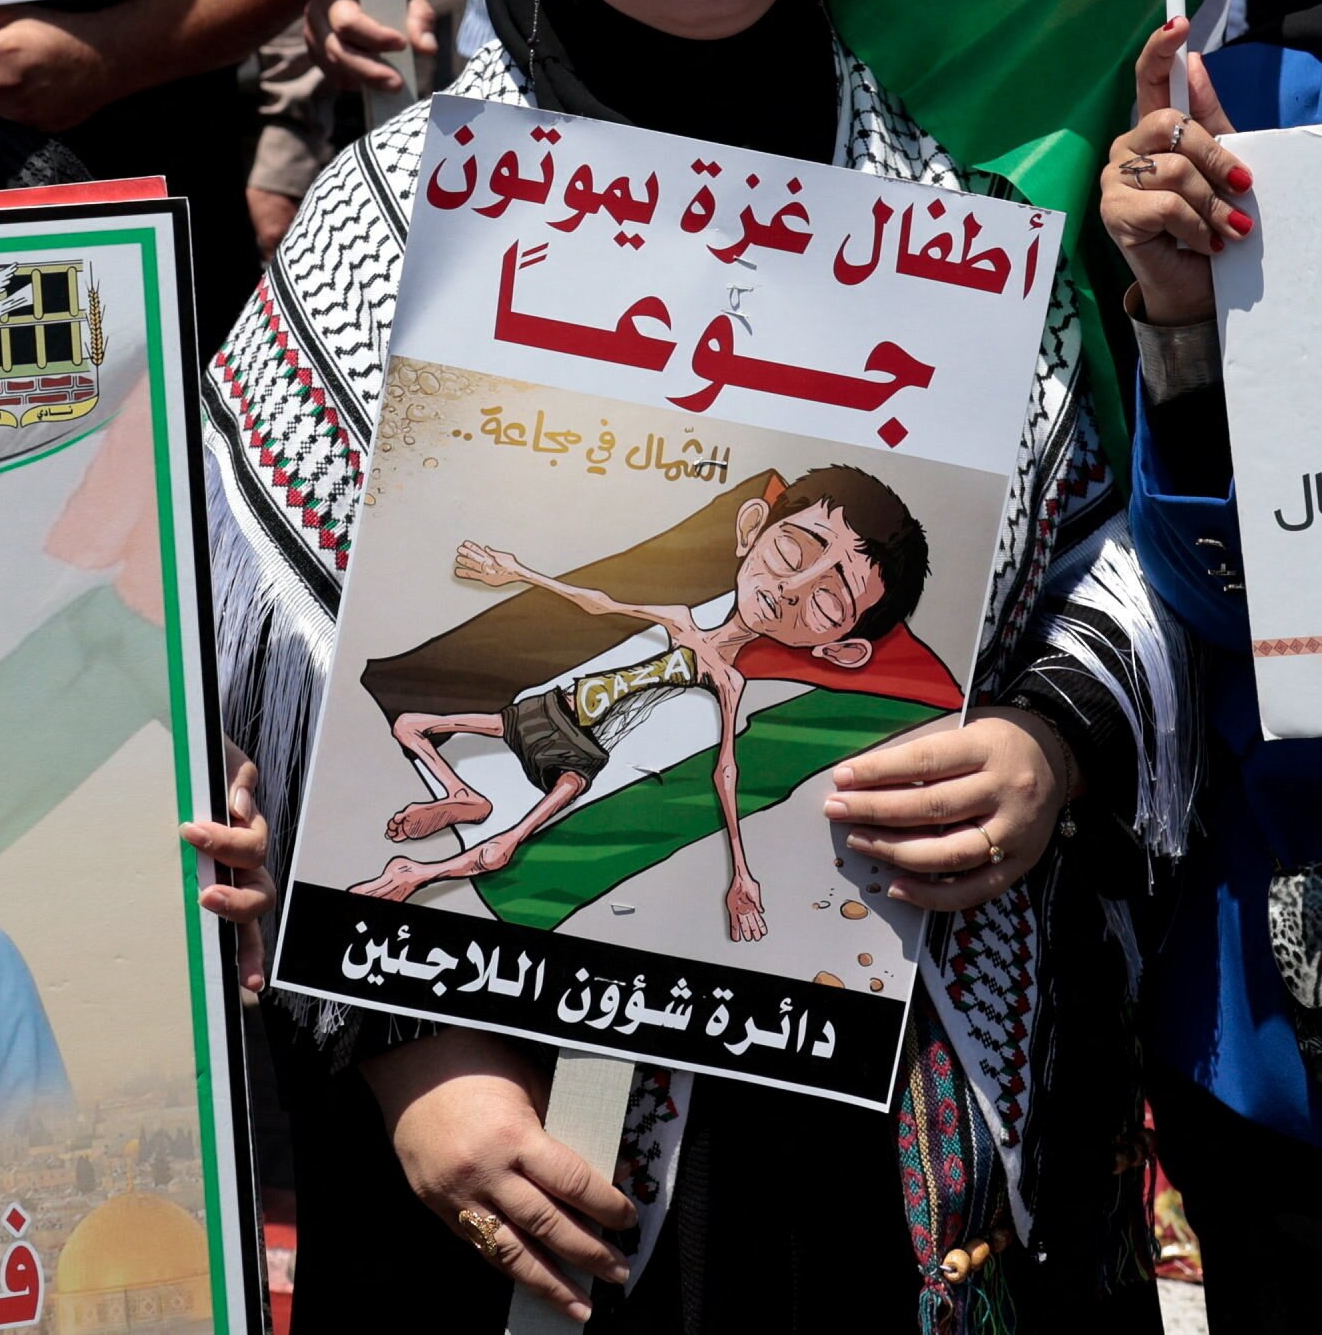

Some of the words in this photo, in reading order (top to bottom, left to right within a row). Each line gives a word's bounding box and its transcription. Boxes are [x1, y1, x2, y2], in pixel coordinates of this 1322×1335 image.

[428, 128, 659, 250] يموتون
[681, 162, 811, 265] غزة
[833, 200, 1042, 299] أطفال
[36, 406, 74, 421] نادي
[586, 418, 617, 476] في
[581, 649, 691, 718] GAZA
[342, 922, 545, 1000] اللاجئين
[558, 968, 692, 1034] شؤون
[709, 988, 836, 1059] دائرة
